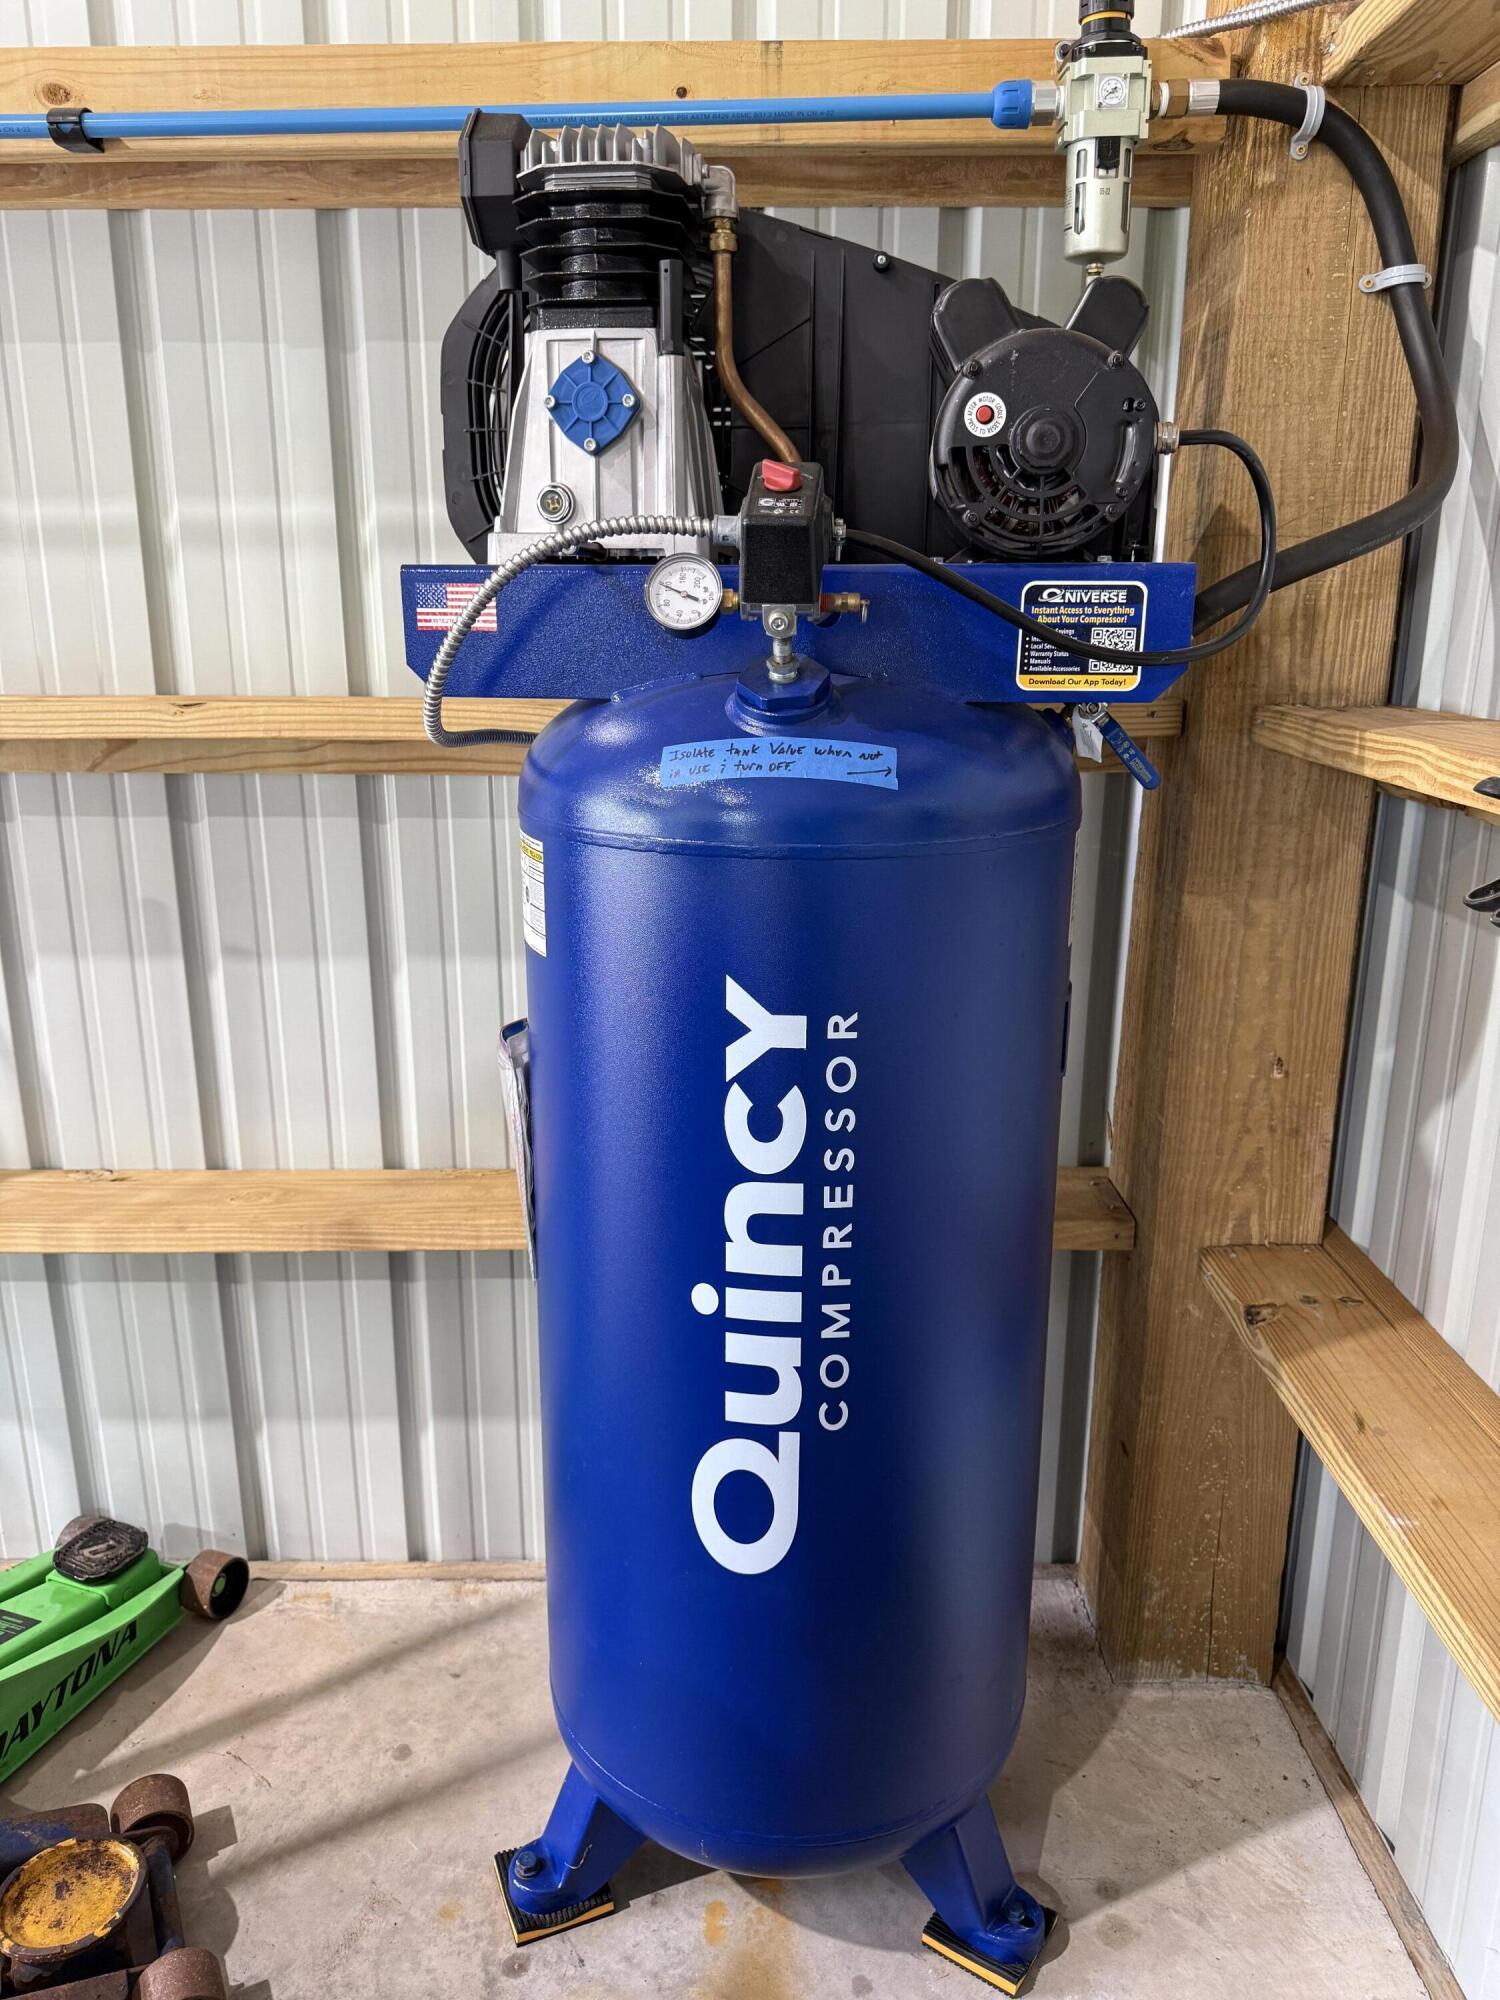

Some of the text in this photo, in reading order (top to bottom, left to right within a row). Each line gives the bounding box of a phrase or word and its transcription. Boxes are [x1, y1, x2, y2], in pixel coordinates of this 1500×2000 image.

[968, 395, 1004, 419] AFTER MOTOR COOLS
[968, 417, 979, 433] PRESS
[987, 420, 1001, 434] RESET
[1032, 605, 1135, 617] Instant Access to Everything
[1037, 615, 1128, 625] About Your Compressor!
[1084, 678, 1100, 686] App
[1101, 678, 1127, 687] Today!
[859, 751, 883, 760] not
[734, 760, 762, 771] turn
[819, 1012, 858, 1431] COMPRESSOR
